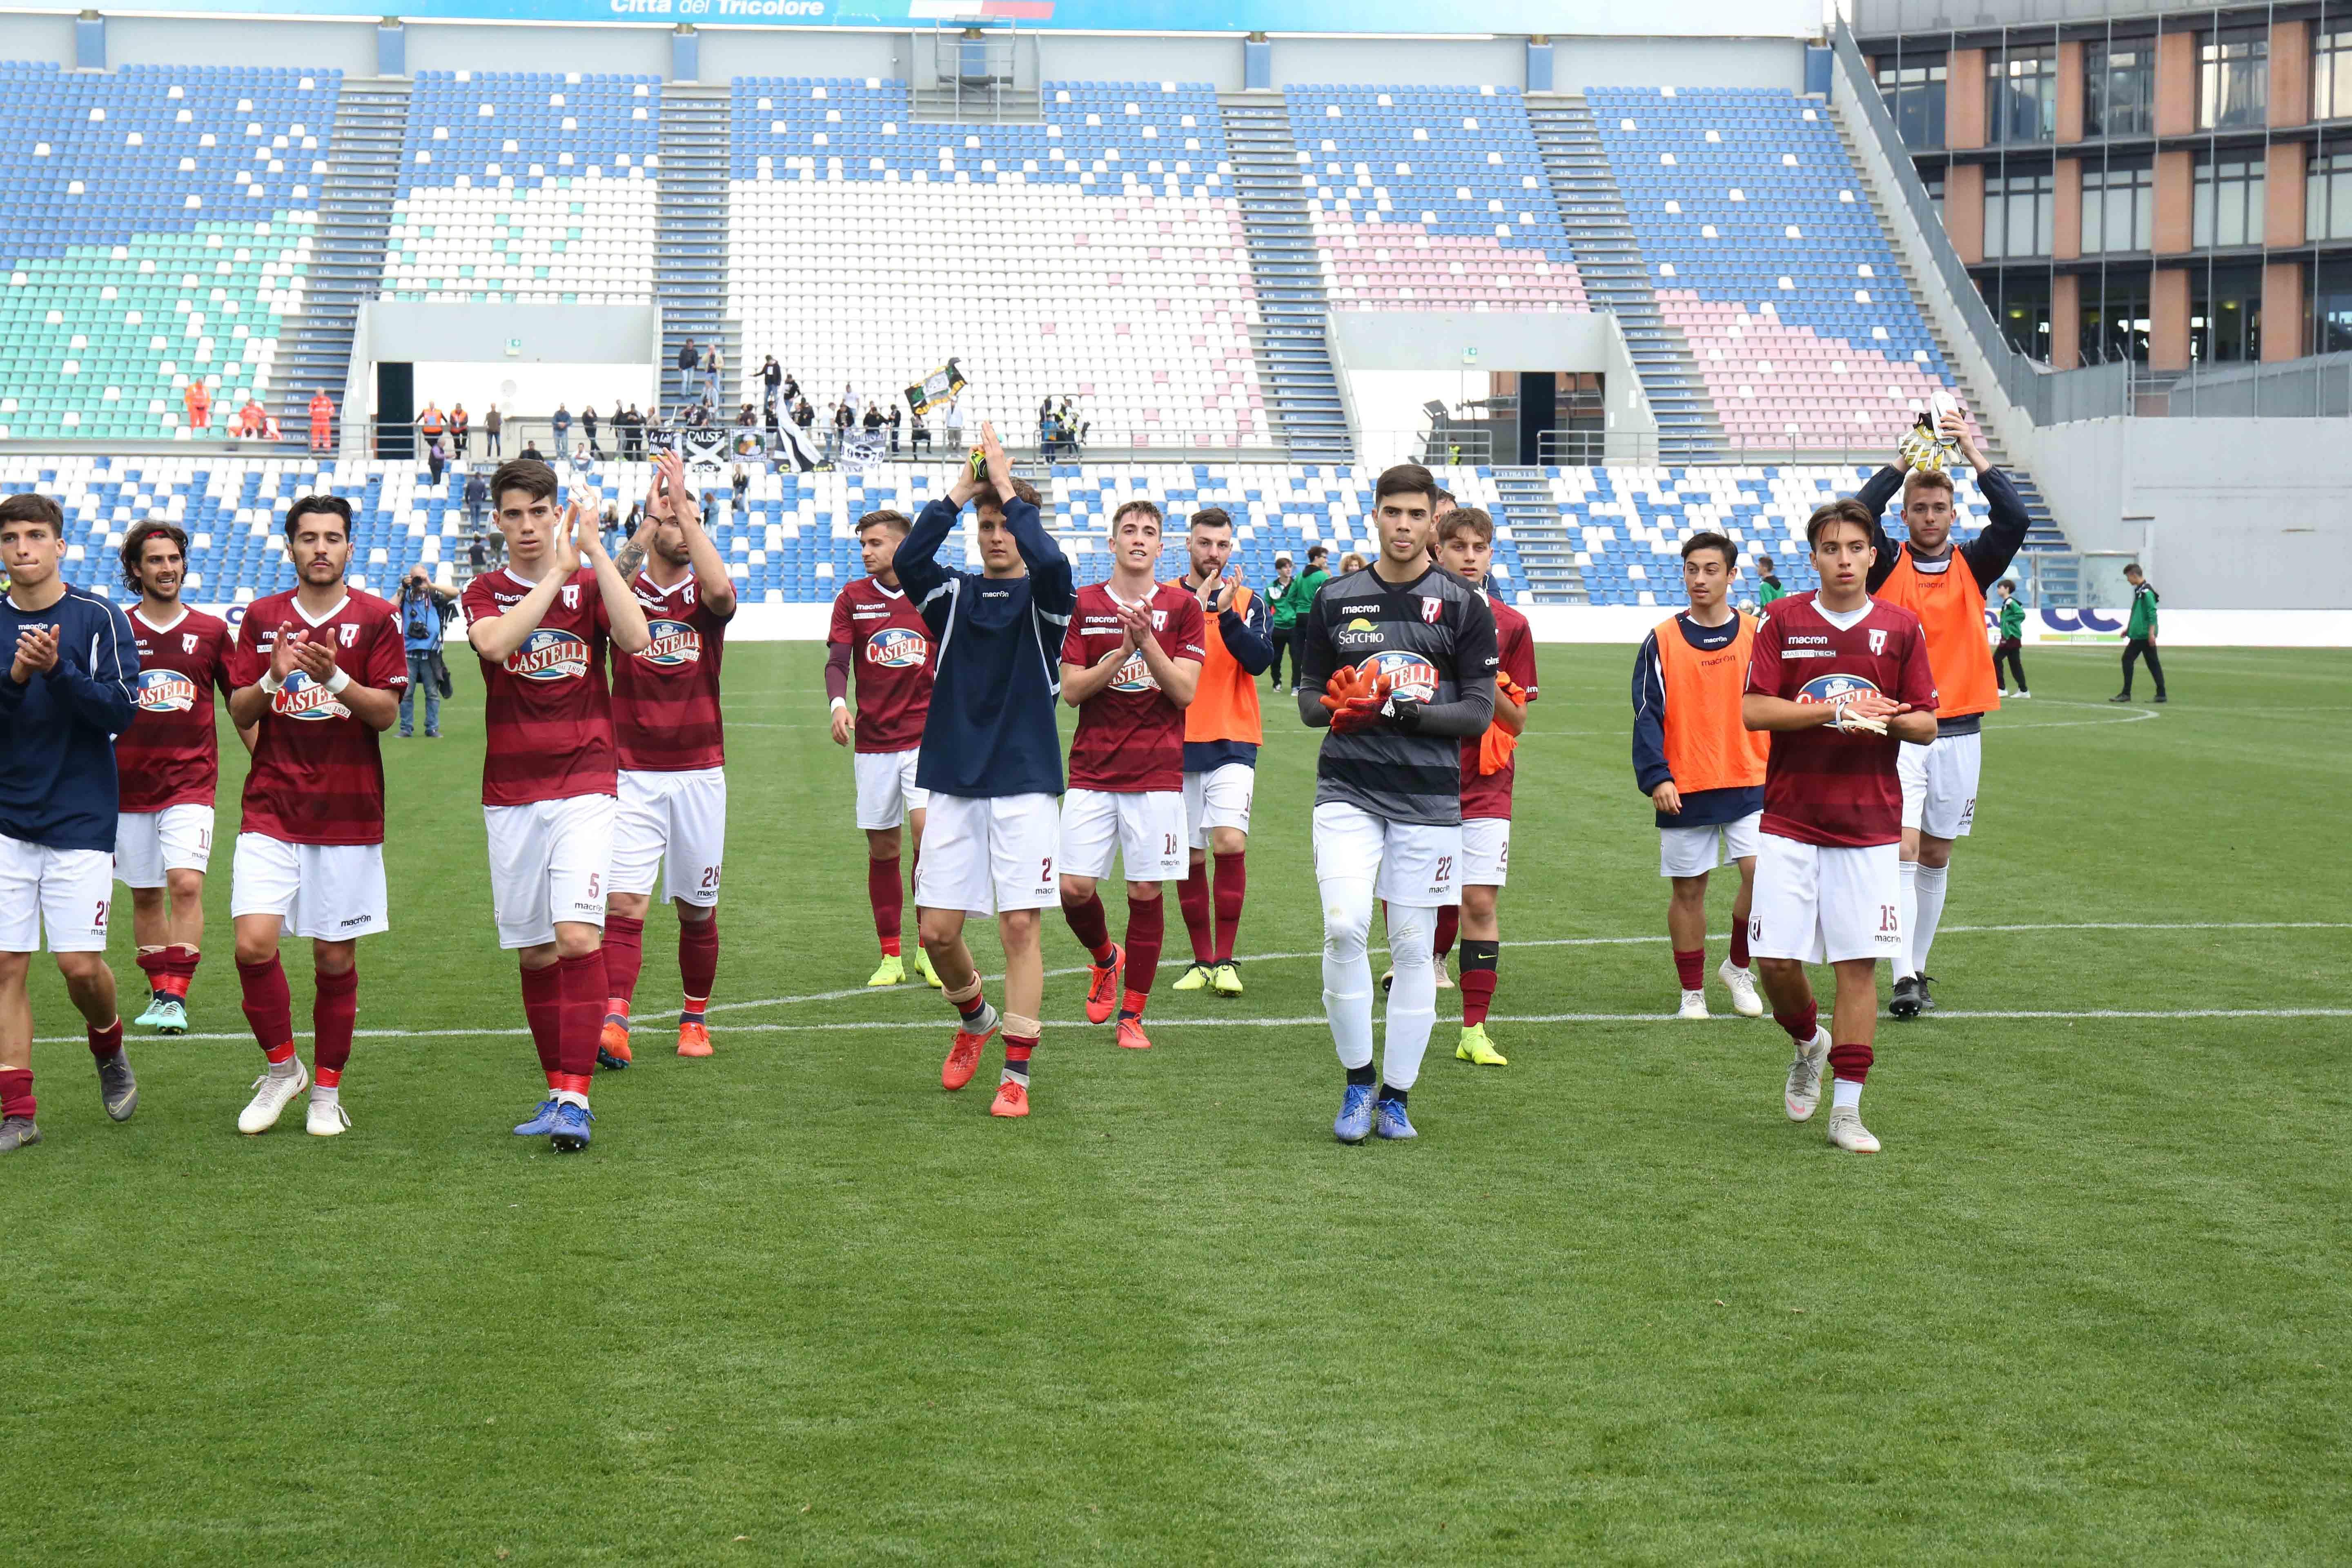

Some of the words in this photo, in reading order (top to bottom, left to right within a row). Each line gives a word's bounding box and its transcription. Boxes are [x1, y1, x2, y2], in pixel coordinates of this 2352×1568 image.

[495, 592, 525, 602] macr
[635, 586, 663, 603] macron
[1342, 605, 1380, 614] macron
[642, 632, 700, 657] ASTELLI
[1788, 636, 1828, 644] macron
[684, 651, 698, 660] 1892
[867, 639, 927, 662] CASTELLI
[1782, 650, 1836, 659] MASTERTECH
[503, 642, 589, 672] CASTELLI
[1702, 655, 1736, 666] macron
[567, 664, 584, 675] 1892
[138, 681, 195, 705] ASTELLI
[1416, 687, 1432, 699] 1892
[333, 705, 350, 717] 1892
[1962, 799, 1975, 817] 12
[1164, 833, 1177, 855] 18
[1435, 855, 1452, 881] 22
[702, 865, 719, 887] 28
[588, 873, 599, 899] 5
[1429, 885, 1450, 894] macrn
[575, 902, 603, 912] macron
[341, 915, 371, 927] macron
[1880, 904, 1897, 931] 15
